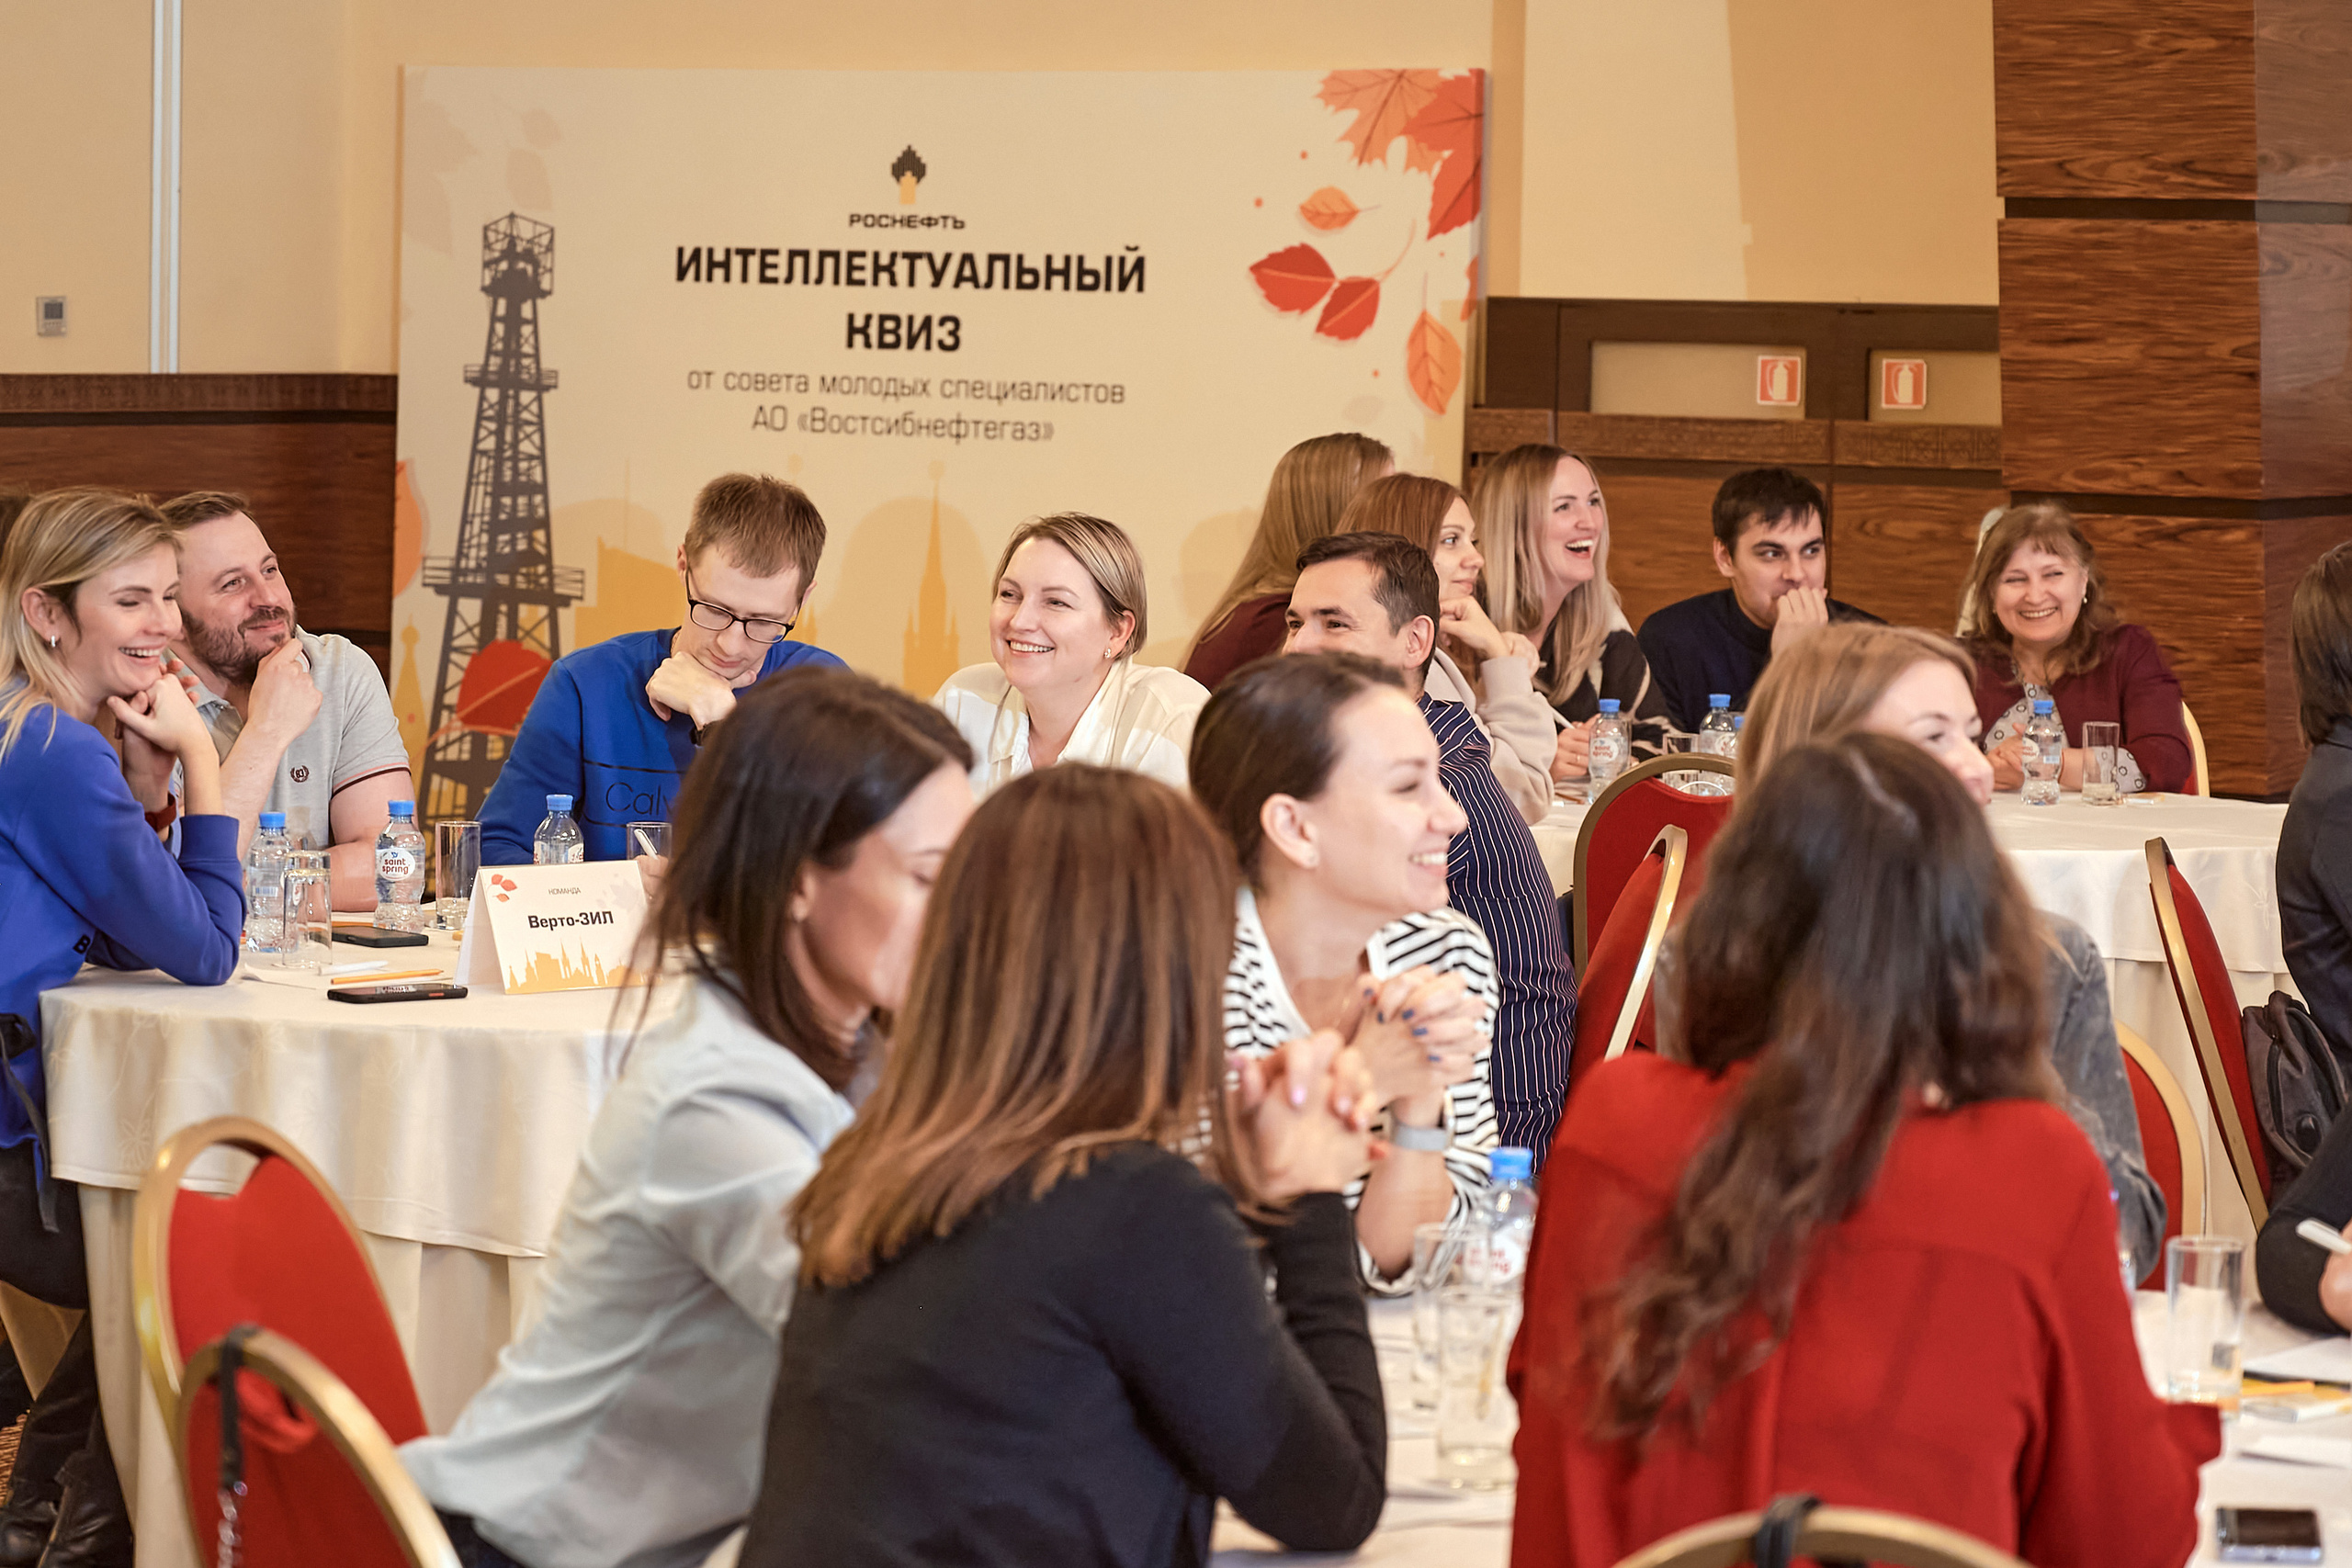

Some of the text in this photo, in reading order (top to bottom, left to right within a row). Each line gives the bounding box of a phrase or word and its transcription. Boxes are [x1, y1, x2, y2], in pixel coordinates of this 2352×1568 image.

[849, 213, 966, 230] РОСНЕФТЬ
[675, 245, 1146, 293] ИНТЕЛЛЕКТУАЛЬНЫЙ
[846, 313, 961, 352] КВИЗ
[687, 370, 1125, 405] от совета молодых специалистов
[752, 405, 1055, 445] АО «Востсибнефтегаз»
[382, 865, 409, 874] spring
[527, 911, 614, 931] Верто-ЗИЛ
